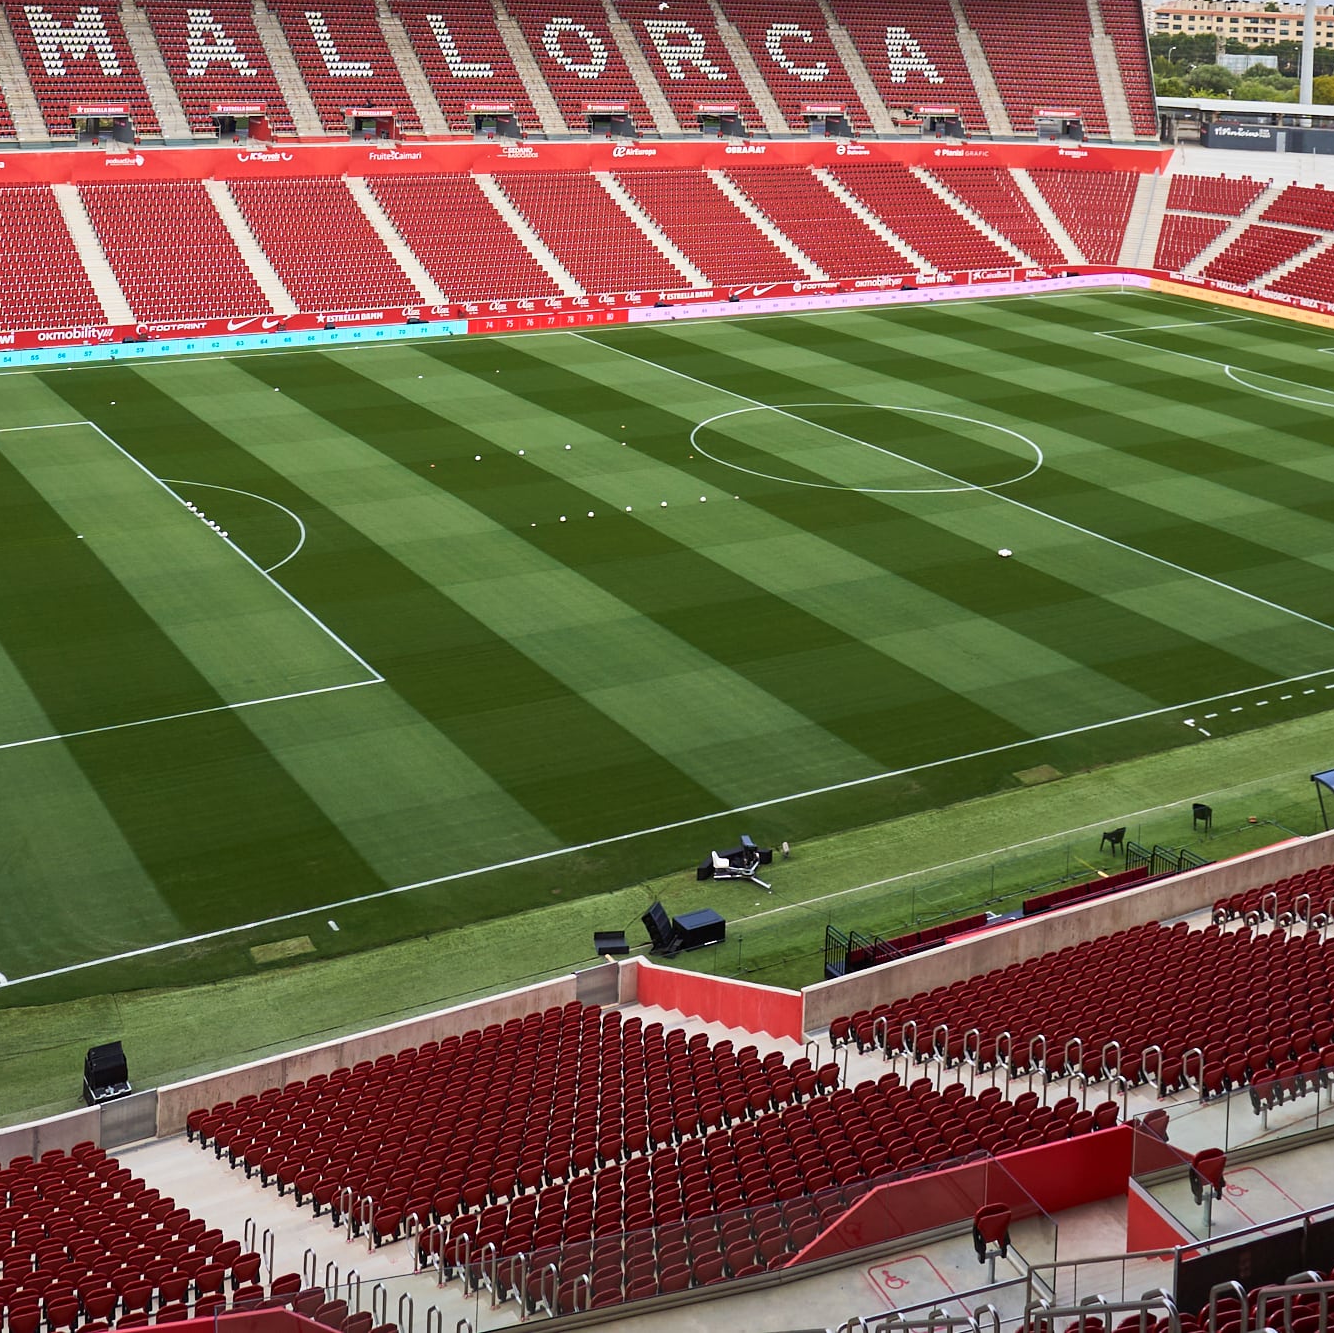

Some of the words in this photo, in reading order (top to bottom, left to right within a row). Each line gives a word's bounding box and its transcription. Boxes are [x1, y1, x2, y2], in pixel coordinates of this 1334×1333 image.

[326, 313, 361, 323] ESTRELLA
[360, 312, 384, 321] DAMM
[547, 317, 555, 325] 77
[586, 314, 594, 322] 79
[486, 321, 494, 329] 74
[526, 318, 534, 326] 76
[148, 322, 208, 332] FOOTPRINT
